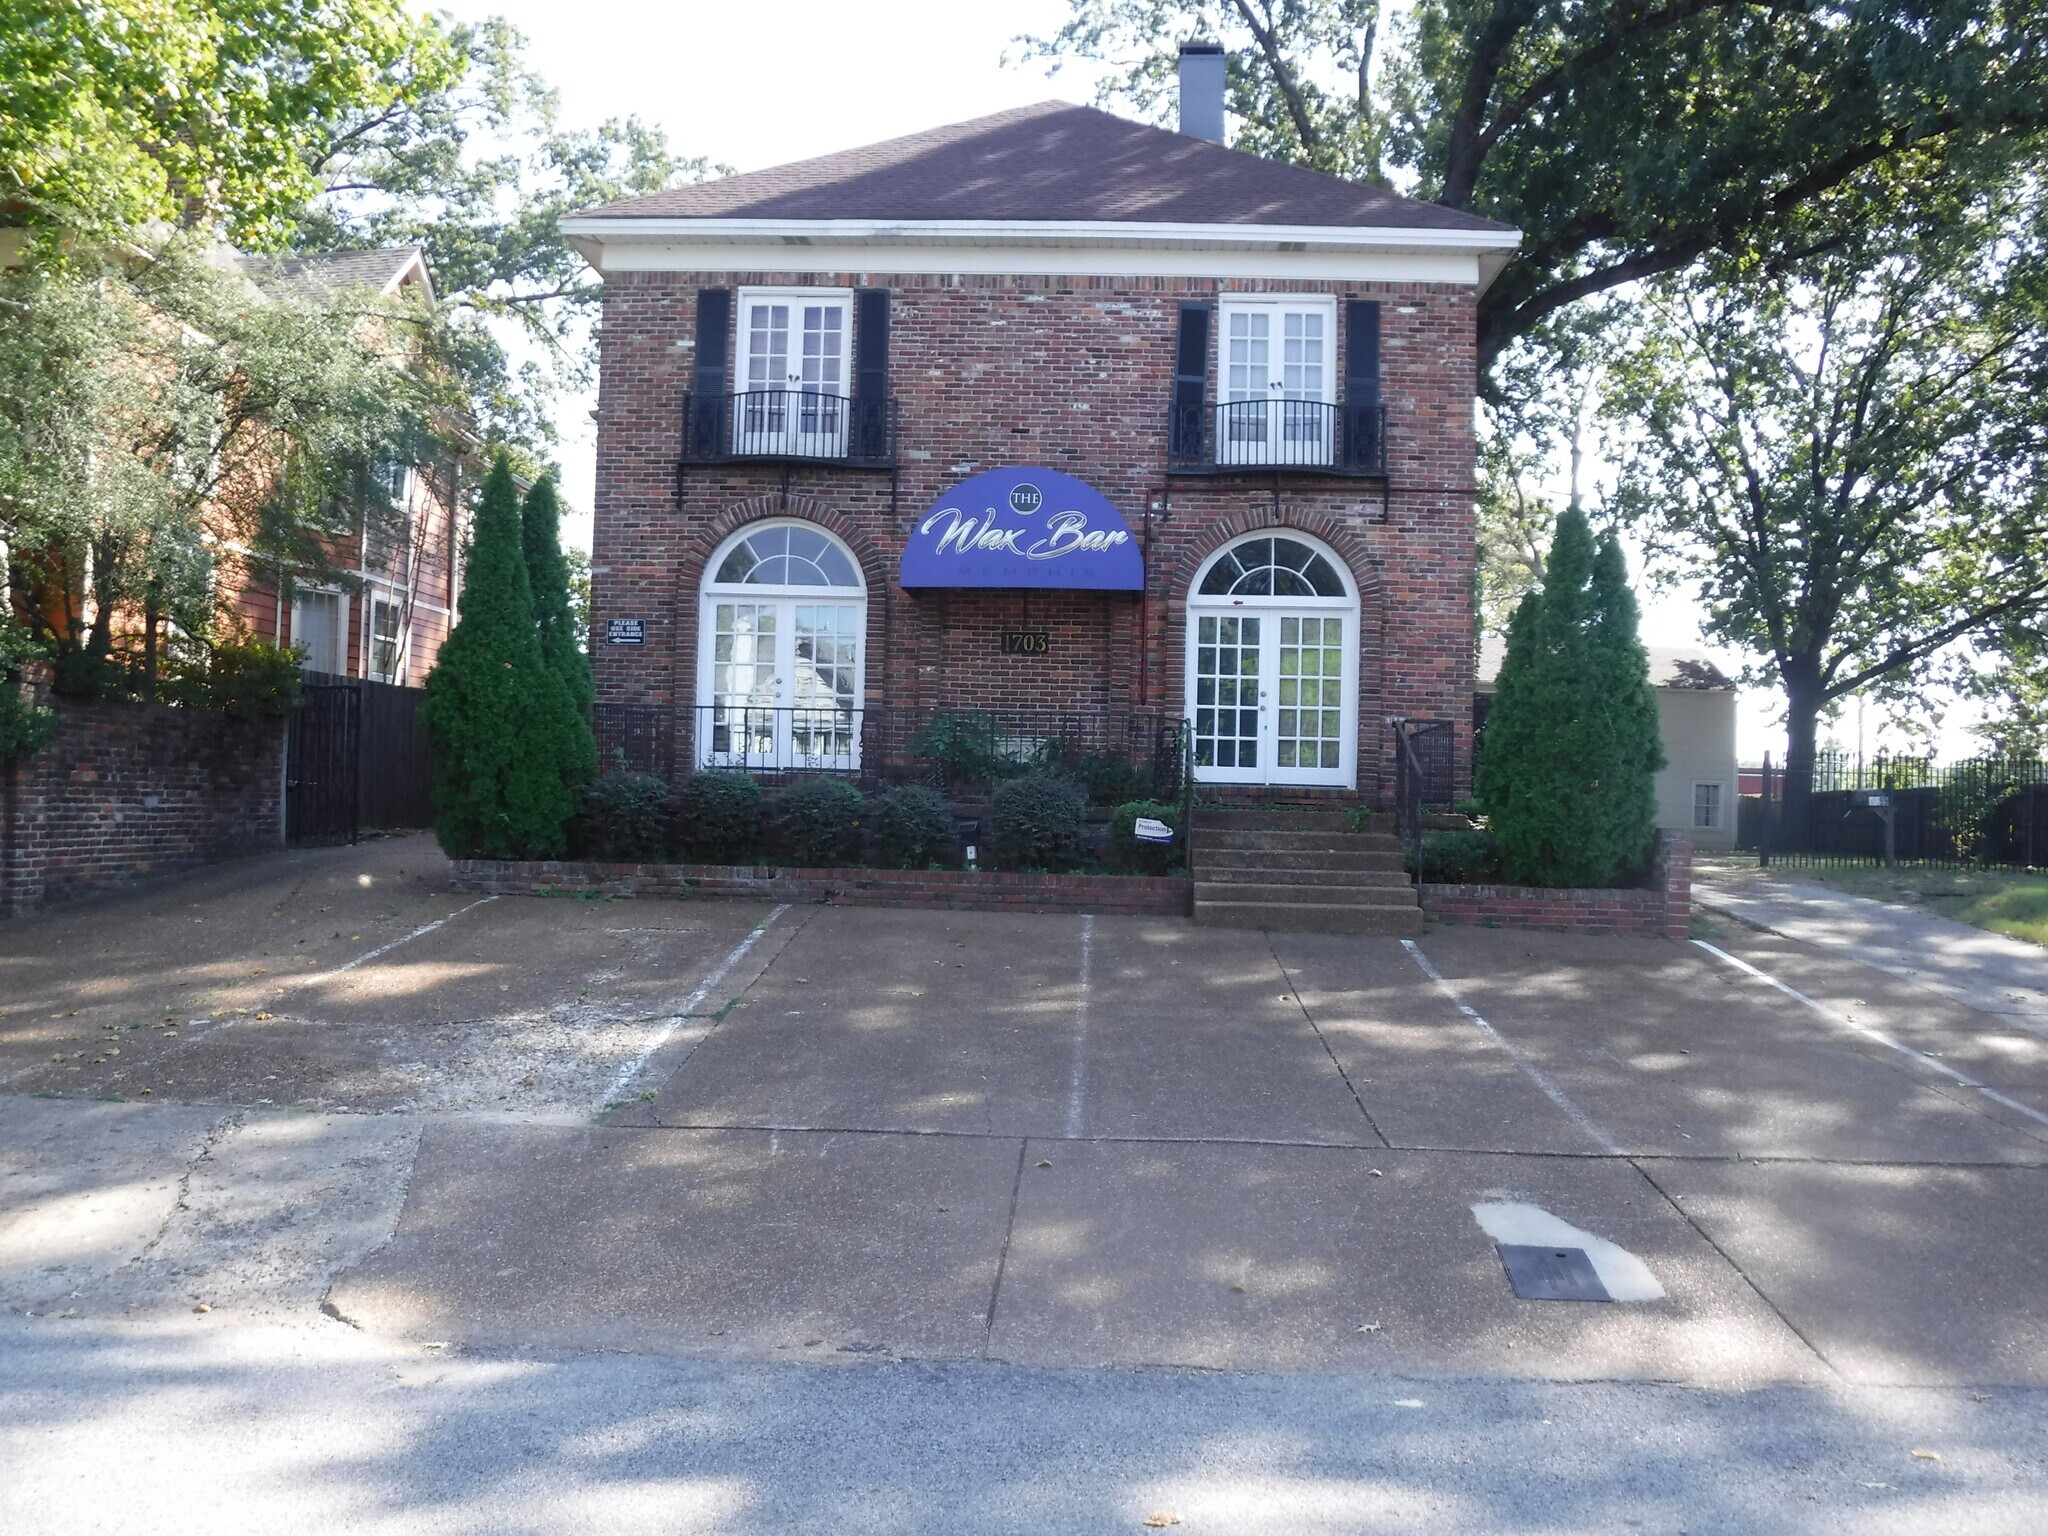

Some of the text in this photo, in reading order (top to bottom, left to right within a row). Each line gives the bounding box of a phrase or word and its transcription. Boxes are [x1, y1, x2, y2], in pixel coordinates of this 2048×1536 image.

[1012, 492, 1039, 504] THE
[920, 507, 1129, 561] Wax Bar
[957, 566, 1097, 578] MEMPHIS
[1005, 634, 1047, 651] 1703
[1138, 823, 1167, 832] Protection
